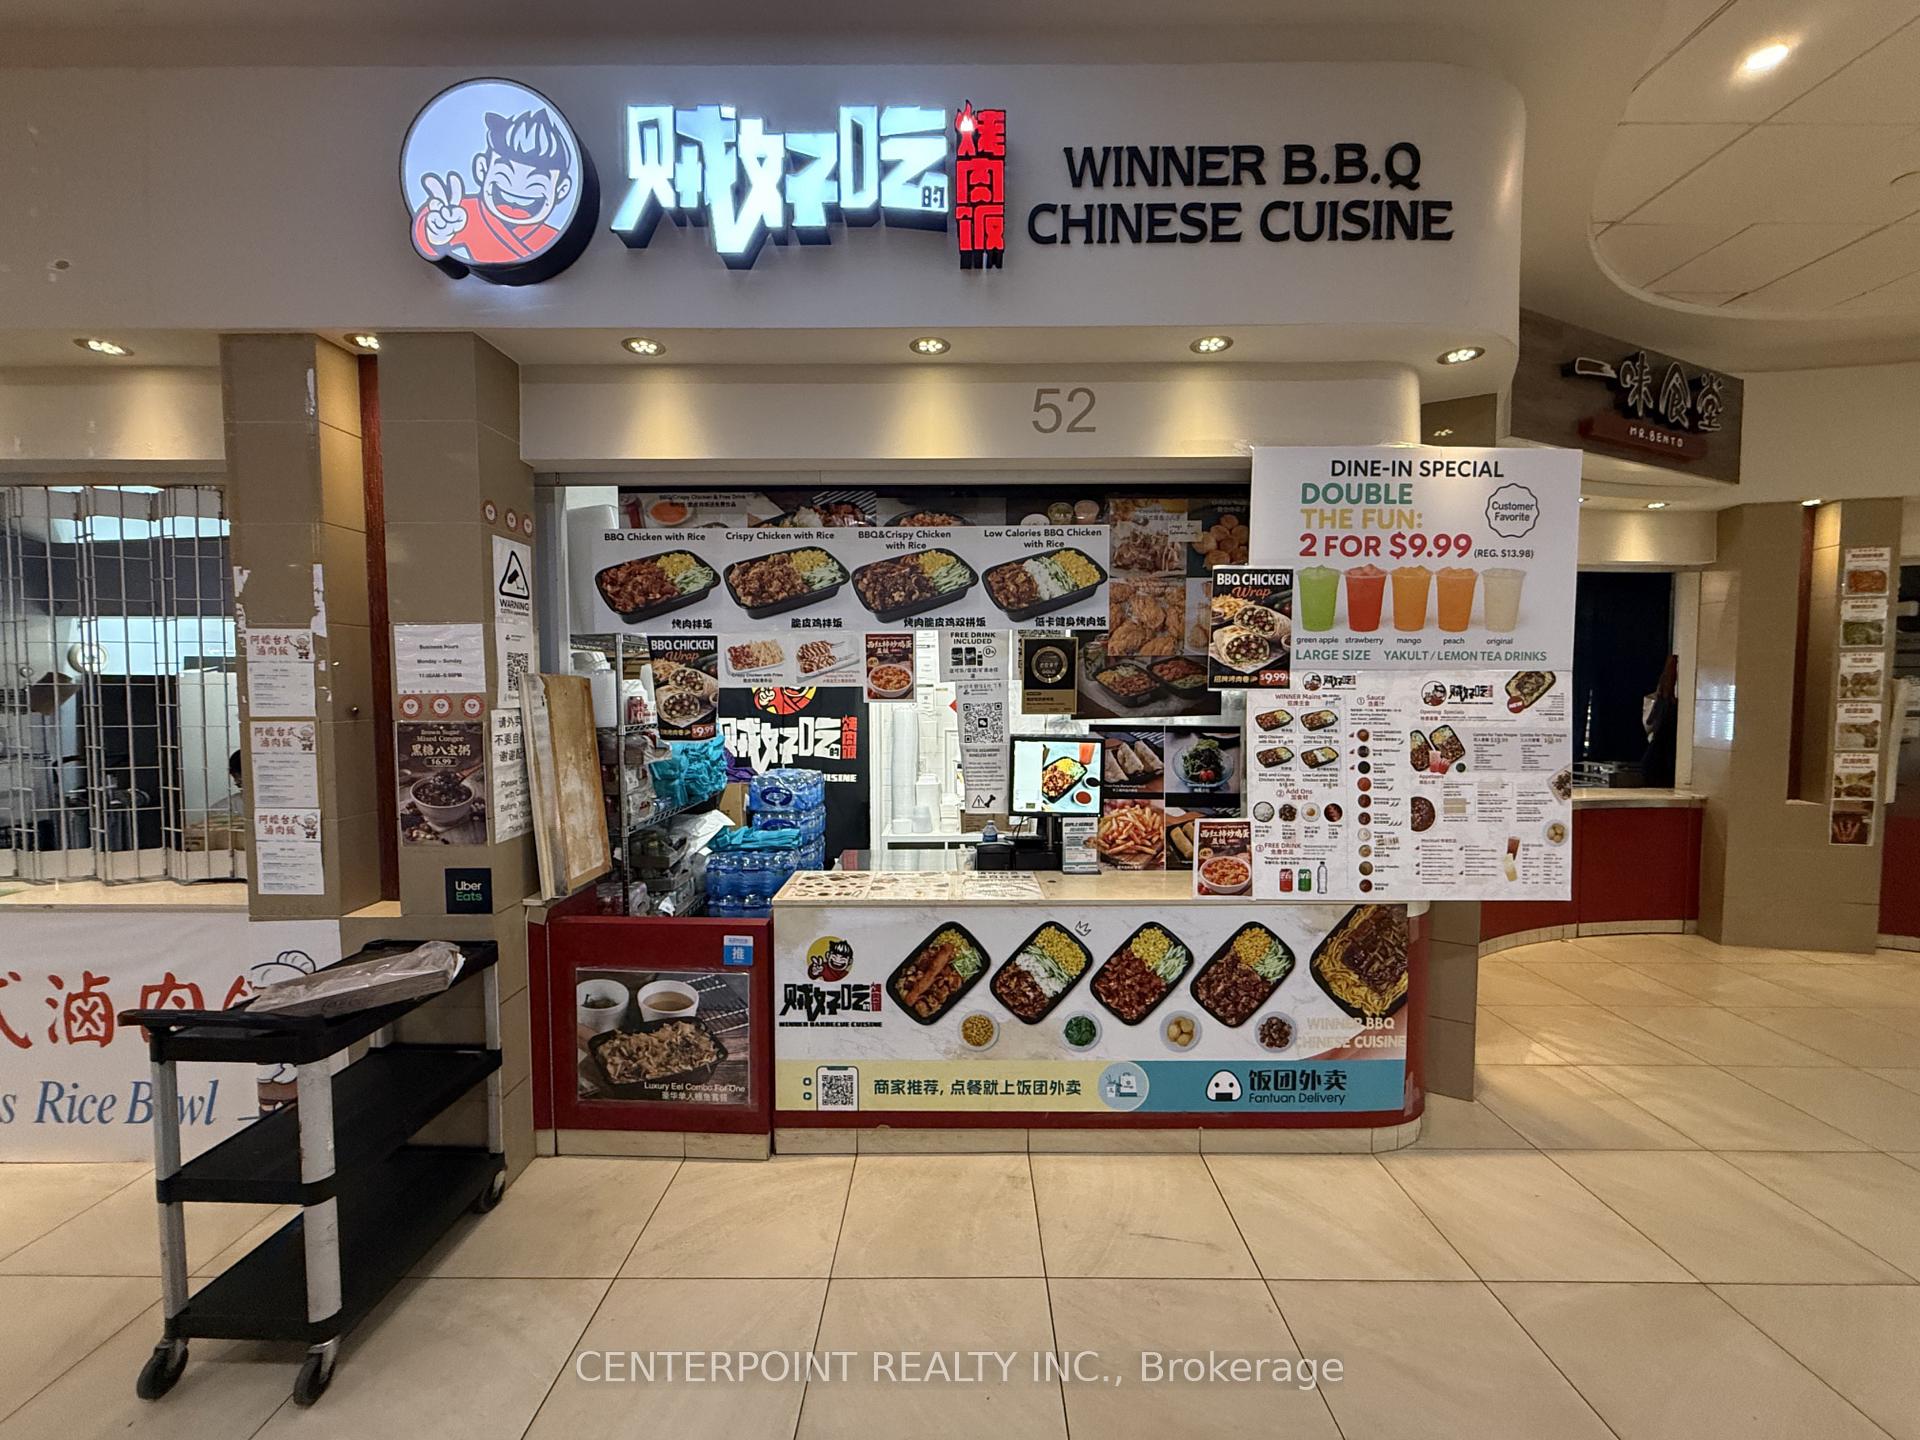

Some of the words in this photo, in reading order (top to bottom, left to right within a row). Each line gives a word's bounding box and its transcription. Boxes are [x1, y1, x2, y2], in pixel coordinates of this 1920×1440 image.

[1063, 145, 1266, 187] WINNER
[1283, 142, 1422, 190] B.B.Q
[1028, 202, 1242, 245] CHINESE
[1260, 200, 1454, 242] CUISINE
[1573, 350, 1725, 432] 一味食堂
[1031, 387, 1096, 433] 52
[1331, 460, 1413, 478] DINE-IN
[1419, 460, 1505, 478] SPECIAL
[1301, 482, 1413, 505] DOUBLE
[1491, 501, 1534, 512] Customer
[1300, 508, 1353, 530] THE
[1362, 508, 1423, 530] FUN:
[1495, 511, 1530, 522] Favorite
[604, 532, 625, 541] BBQ
[627, 532, 663, 541] Chicken
[664, 532, 685, 541] with
[687, 532, 706, 541] Rice
[725, 531, 754, 543] Crispy
[756, 531, 789, 540] Chicken
[791, 531, 814, 540] with
[817, 531, 835, 540] Rice
[858, 530, 914, 541] BBQ&Crispy
[916, 529, 951, 539] Chicken
[984, 529, 1002, 538] Low
[1005, 529, 1041, 538] Calories
[1044, 529, 1064, 538] BBQ
[1066, 528, 1102, 537] Chicken
[885, 541, 906, 549] with
[908, 541, 927, 549] Rice
[1023, 539, 1044, 548] with
[1046, 539, 1065, 548] Rice
[1299, 533, 1317, 557] 2
[1324, 535, 1381, 557] FOR
[1389, 531, 1473, 560] $9.99
[1473, 548, 1499, 559] (REG.
[1501, 548, 1534, 559] $13.98)
[1217, 573, 1240, 586] BBQ
[1242, 573, 1290, 586] CHICKEN
[1232, 586, 1272, 599] Wrap
[500, 599, 530, 611] WARNING
[651, 640, 672, 650] BBQ
[673, 640, 715, 650] CHICKEN
[1296, 637, 1316, 645] green
[1318, 637, 1339, 646] apple
[1345, 636, 1384, 646] strawberry
[1396, 638, 1422, 646] mango
[1443, 636, 1465, 646] peach
[1486, 636, 1513, 646] original
[665, 651, 700, 662] Wrap
[1296, 649, 1338, 661] LARGE
[1342, 649, 1371, 661] SIZE
[1384, 650, 1429, 661] YAKULT
[1437, 650, 1478, 661] LEMON
[1480, 651, 1503, 661] TEA
[1504, 651, 1547, 662] DRINKS
[455, 881, 482, 891] Uber
[456, 891, 483, 902] Eats
[731, 947, 745, 960] 推
[1307, 1017, 1363, 1030] WINNER
[1365, 1017, 1396, 1030] BBQ
[1295, 1035, 1352, 1049] CHINESE
[1354, 1035, 1407, 1049] CUISINE
[1248, 1070, 1347, 1091] 饭团外卖
[644, 1082, 670, 1091] Luxury
[671, 1082, 684, 1090] Eel
[685, 1083, 713, 1091] Combo
[727, 1084, 746, 1093] One
[34, 1080, 117, 1125] Rice
[128, 1079, 219, 1126] Bwl
[1248, 1094, 1295, 1103] Fantuan
[1299, 1094, 1346, 1105] Delivery
